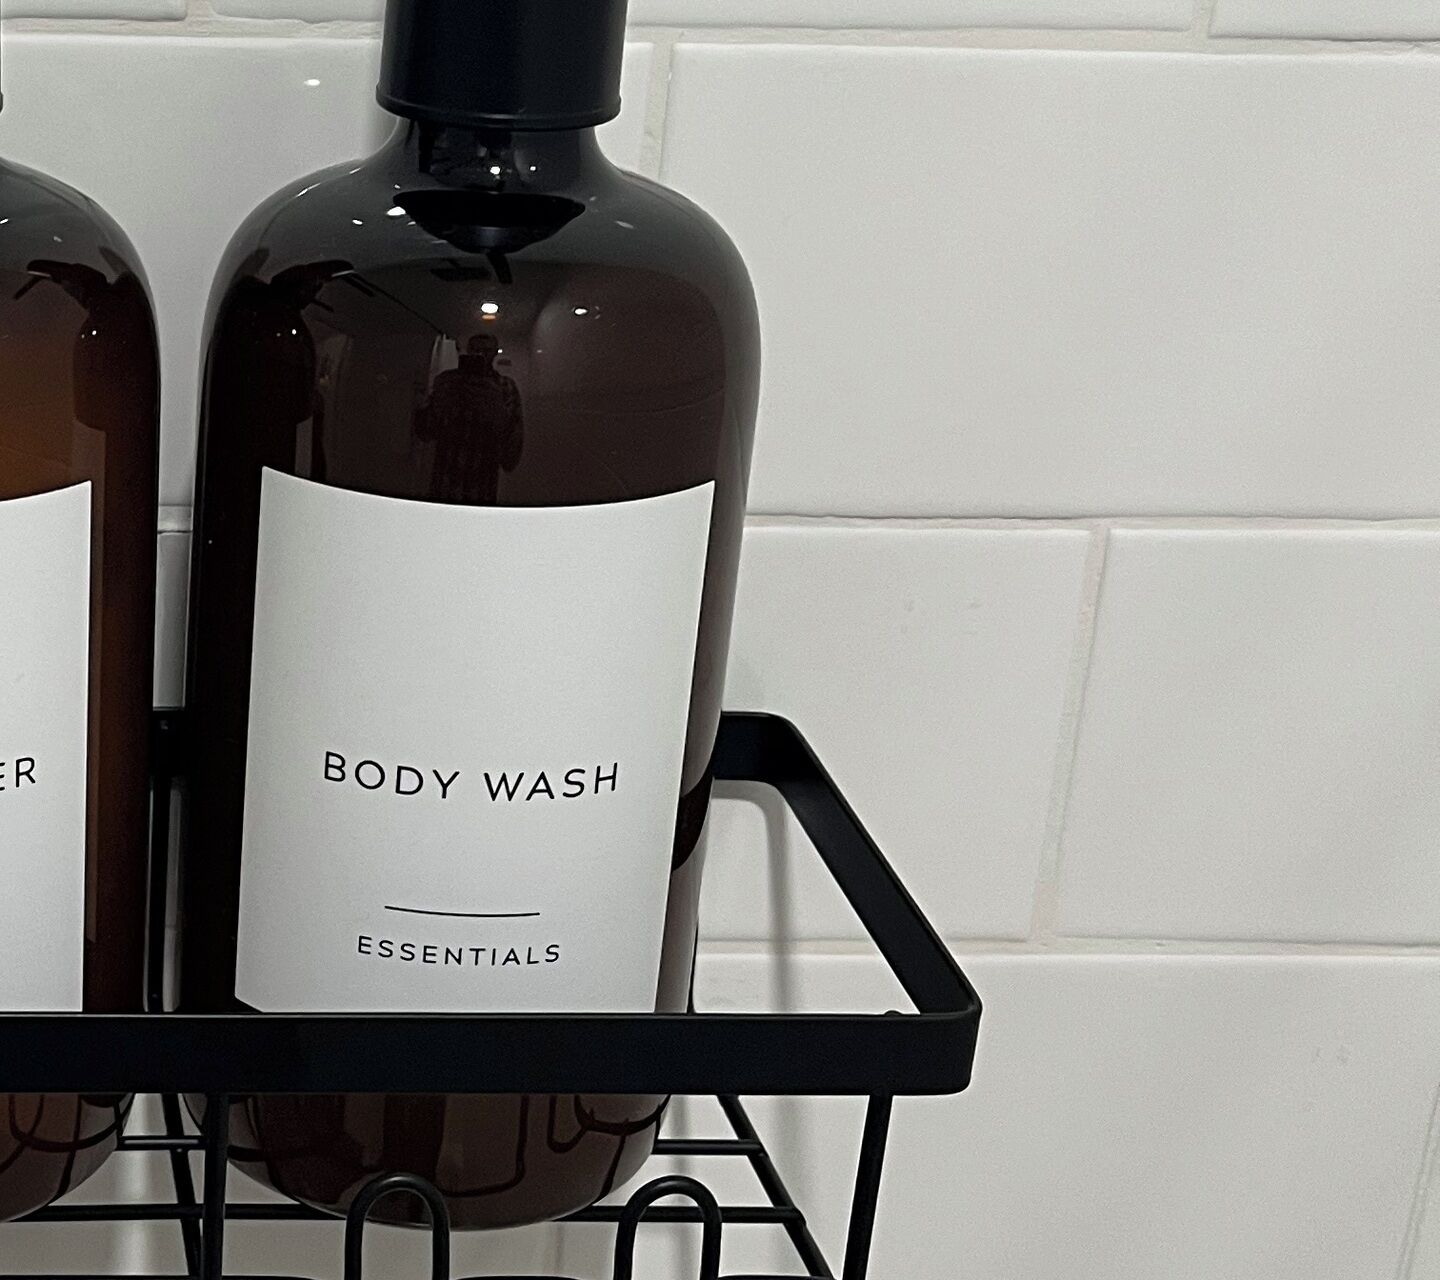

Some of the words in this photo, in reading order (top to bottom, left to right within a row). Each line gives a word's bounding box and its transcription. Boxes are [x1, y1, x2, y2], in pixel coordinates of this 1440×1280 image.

[323, 750, 461, 800] BODY
[482, 761, 619, 802] WASH
[357, 934, 561, 967] ESSENTIALS
